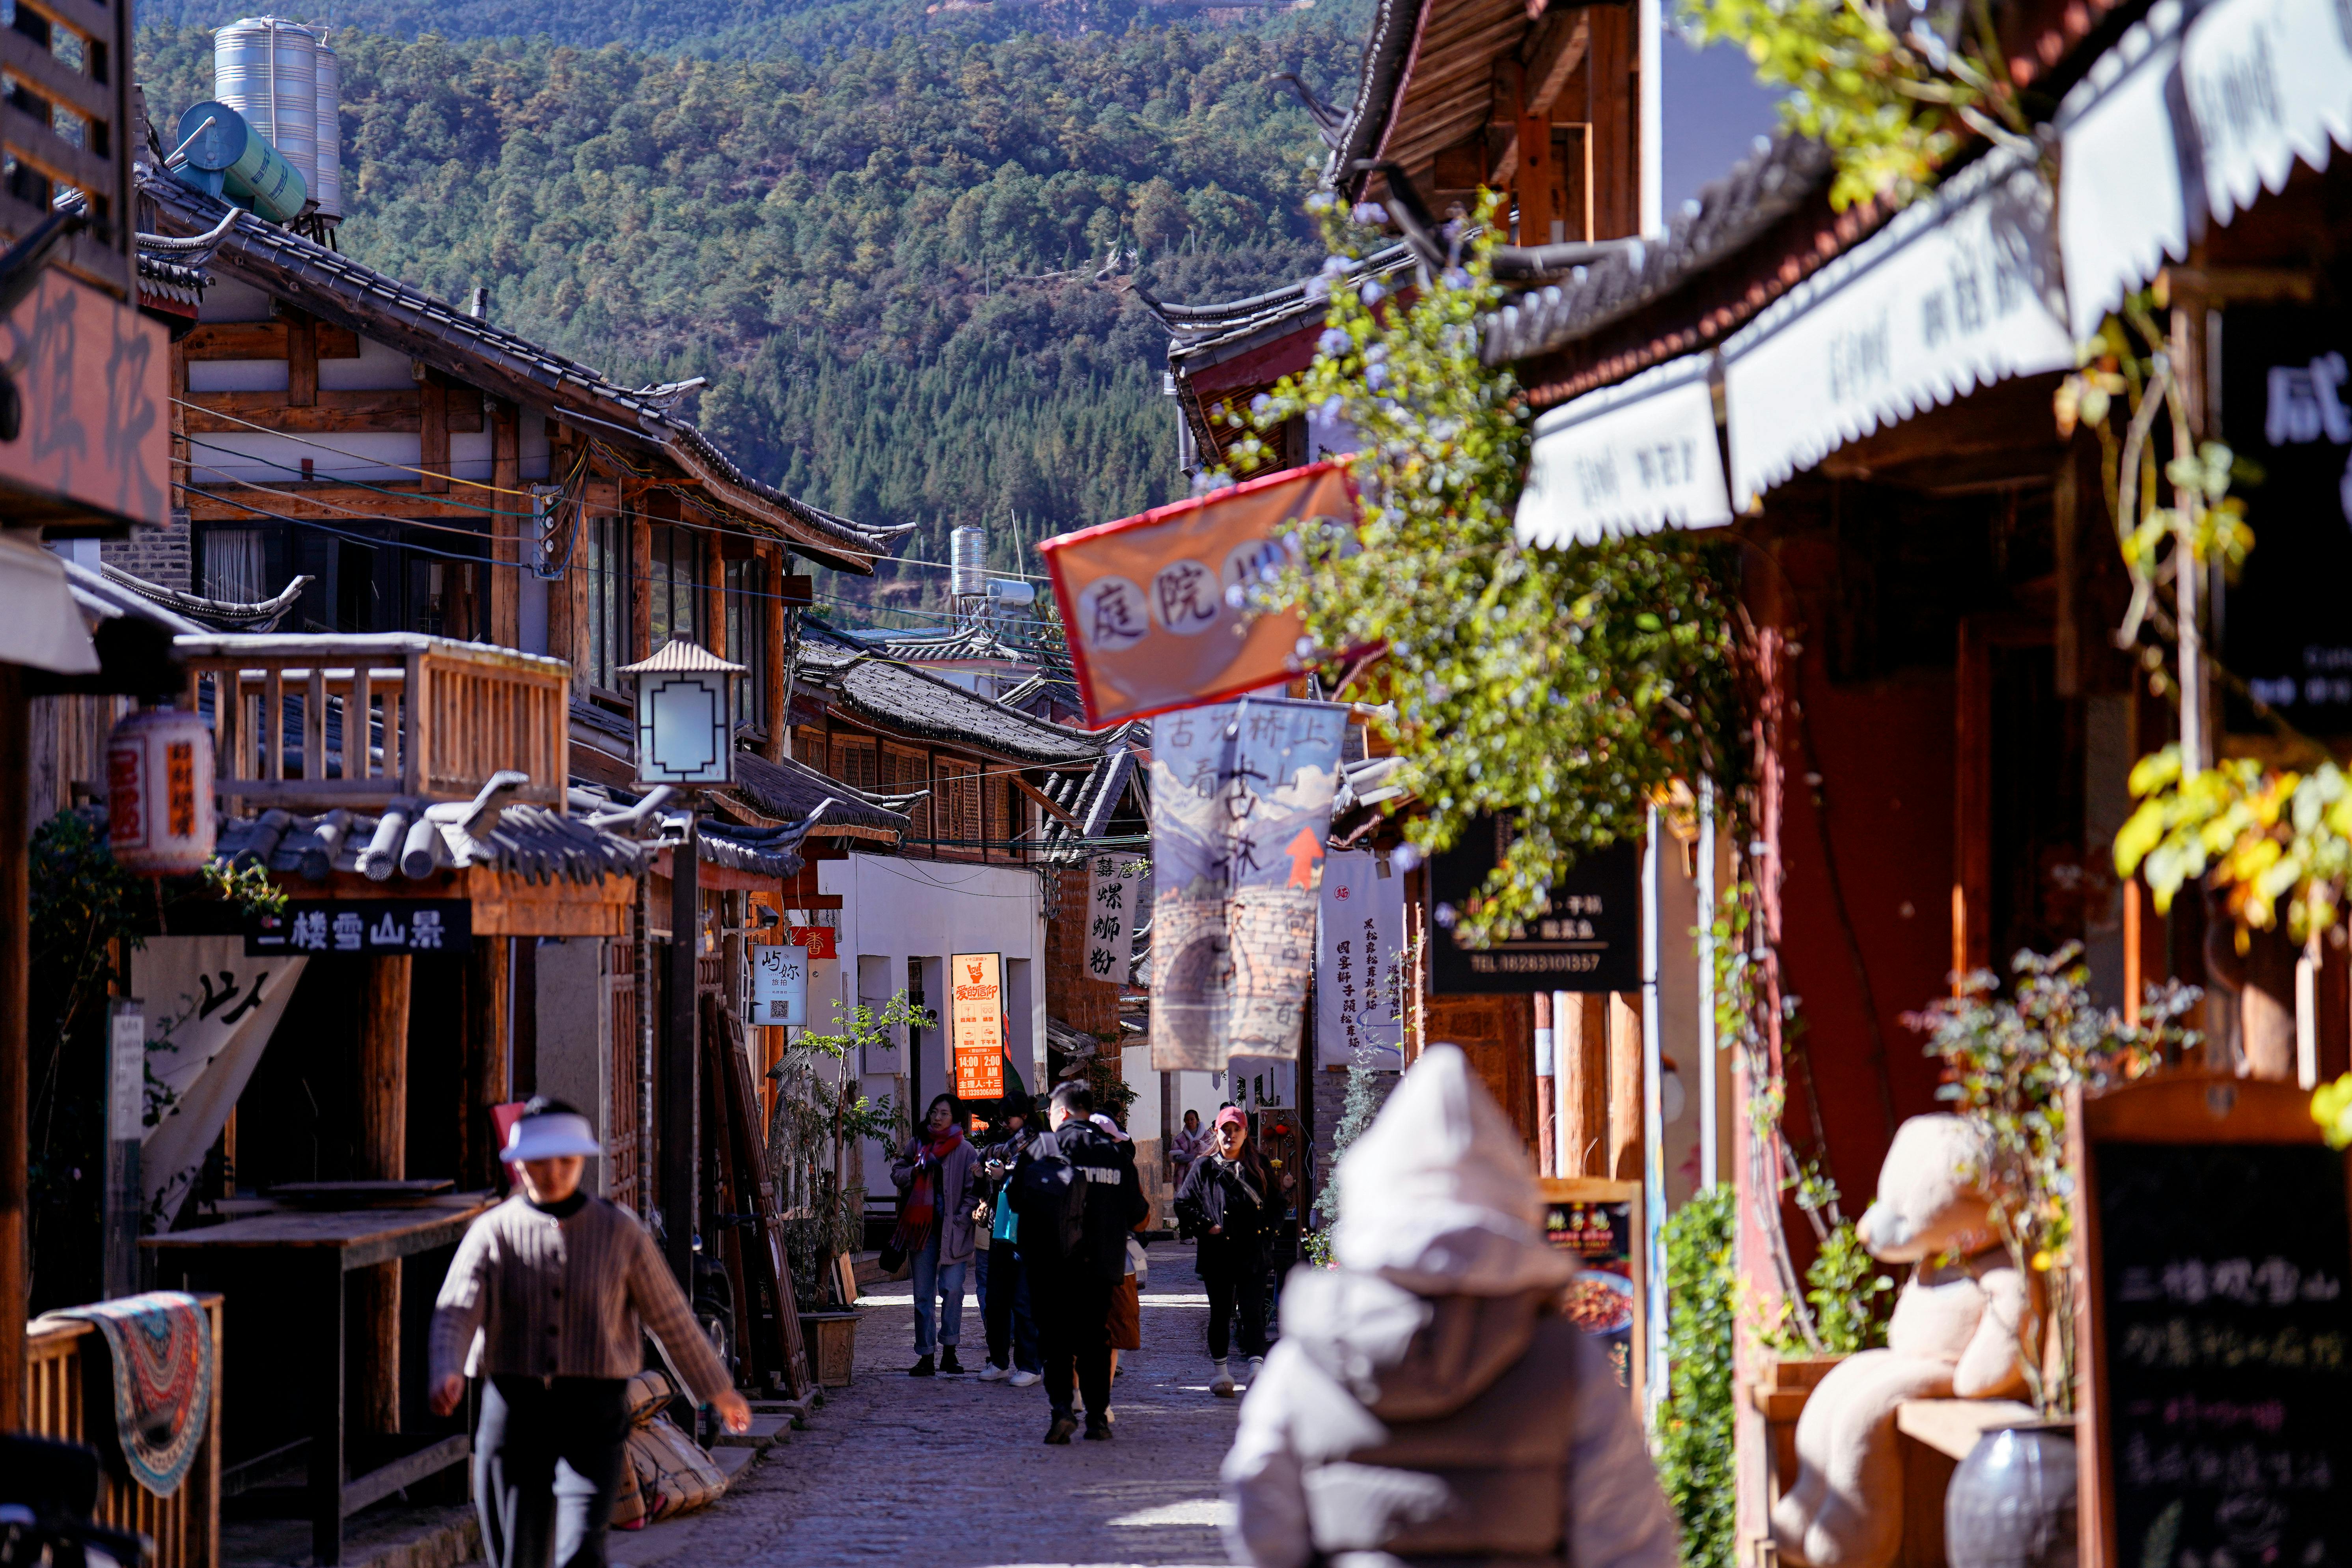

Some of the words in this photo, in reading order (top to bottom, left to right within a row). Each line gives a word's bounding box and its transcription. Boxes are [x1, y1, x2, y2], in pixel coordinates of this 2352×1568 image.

[258, 911, 445, 950] 二楼雪山景
[1090, 883, 1123, 975] 螺蛳粉
[956, 984, 998, 1001] 爱的信仰
[959, 1056, 979, 1067] 14:00
[984, 1055, 1000, 1066] 2:00
[964, 1068, 974, 1078] PM
[987, 1067, 998, 1077] AM
